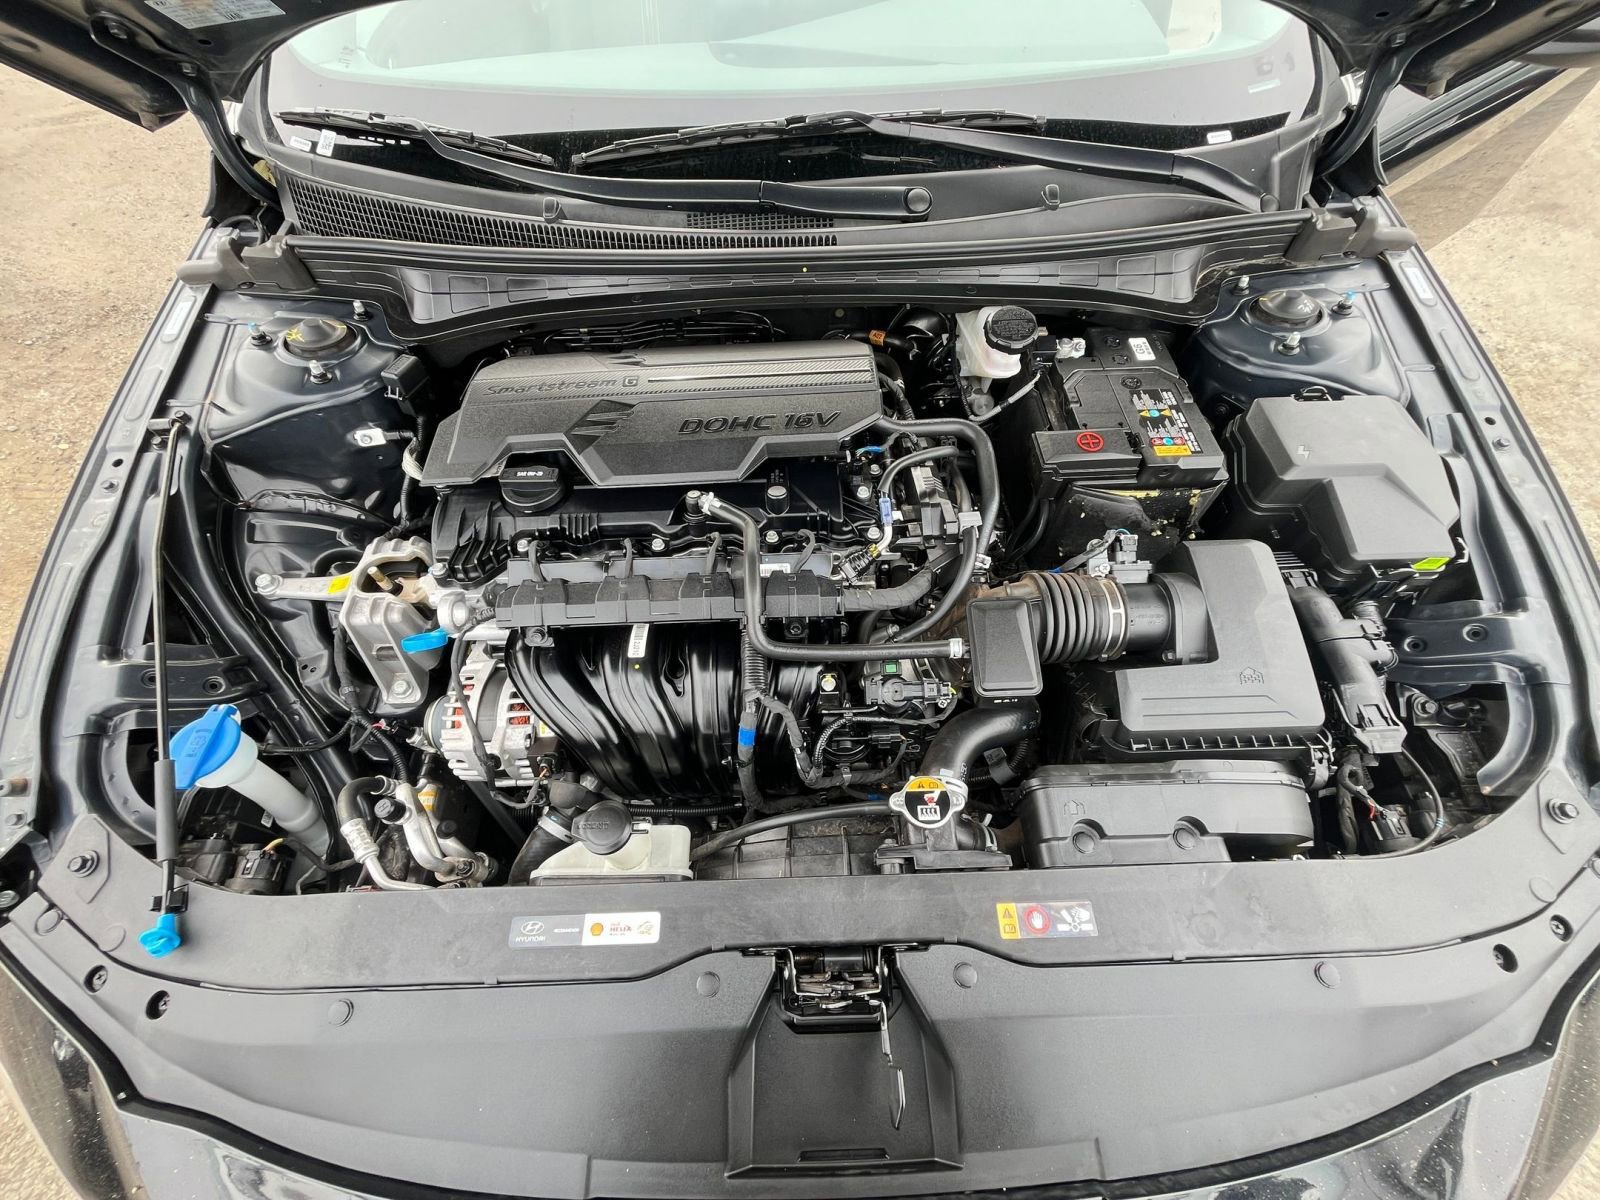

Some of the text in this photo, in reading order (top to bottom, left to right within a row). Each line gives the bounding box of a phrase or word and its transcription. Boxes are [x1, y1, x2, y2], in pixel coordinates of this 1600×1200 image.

[483, 379, 617, 396] Smartstream
[678, 410, 841, 435] DOHC 16V
[515, 935, 546, 943] HYUNDAI
